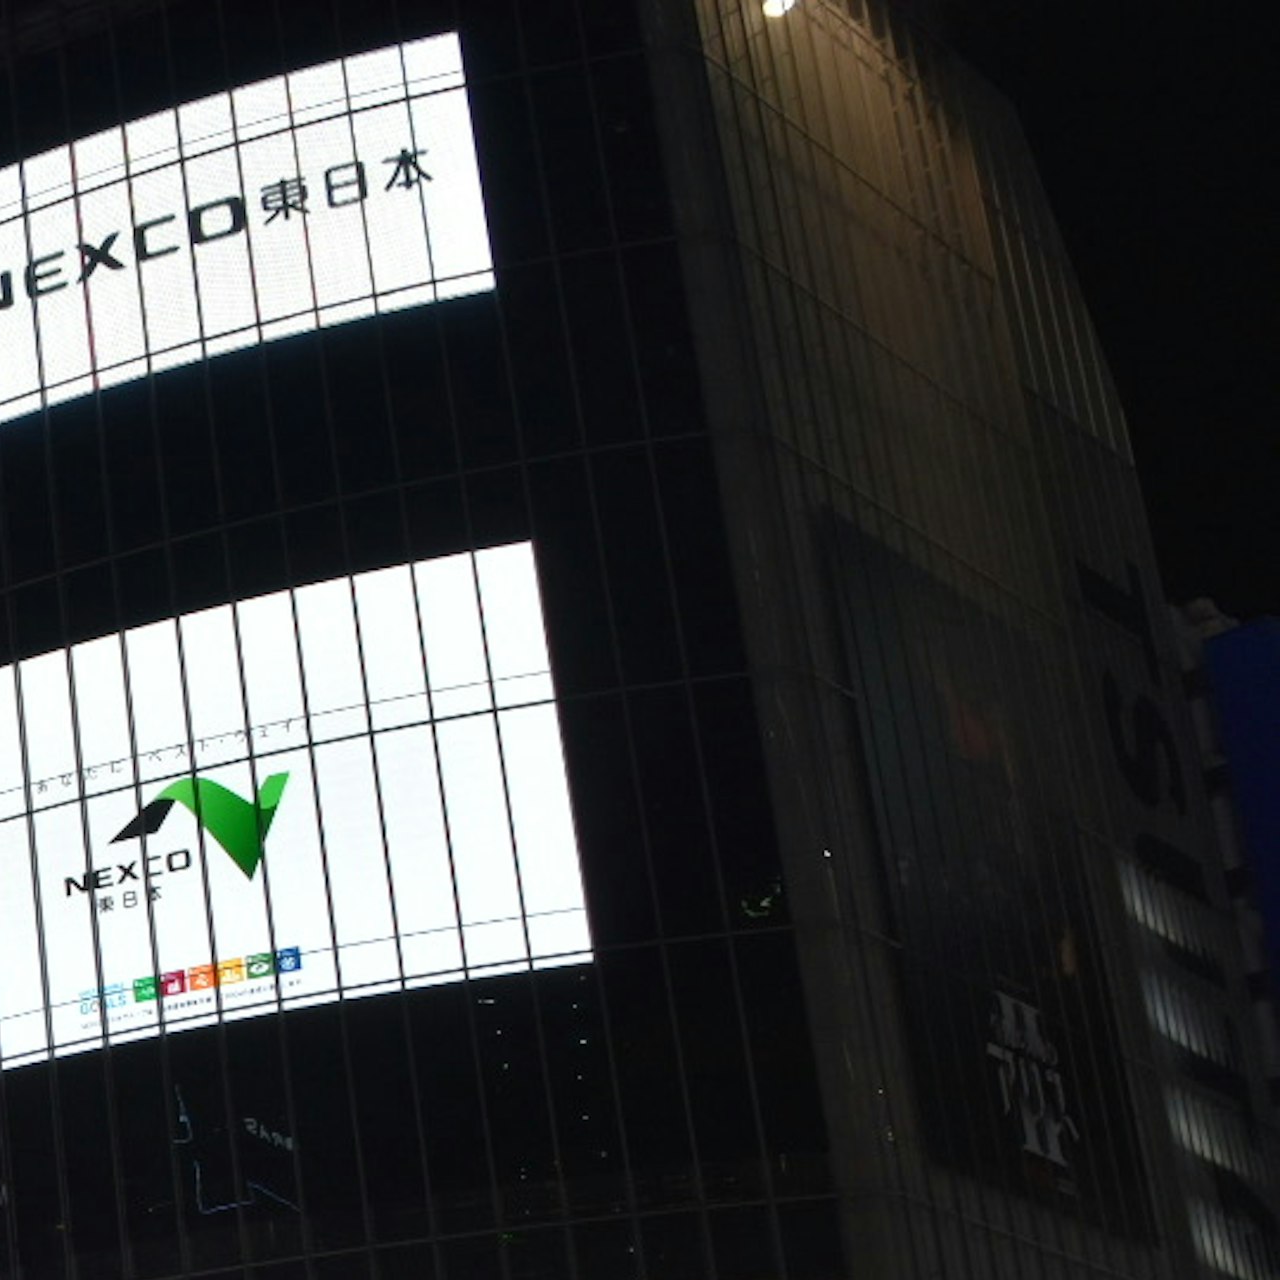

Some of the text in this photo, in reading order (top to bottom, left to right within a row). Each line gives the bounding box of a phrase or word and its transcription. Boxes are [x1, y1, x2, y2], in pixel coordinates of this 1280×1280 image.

[260, 146, 433, 226] 東日本
[64, 849, 192, 897] NEXCO
[98, 887, 162, 913] 東日本
